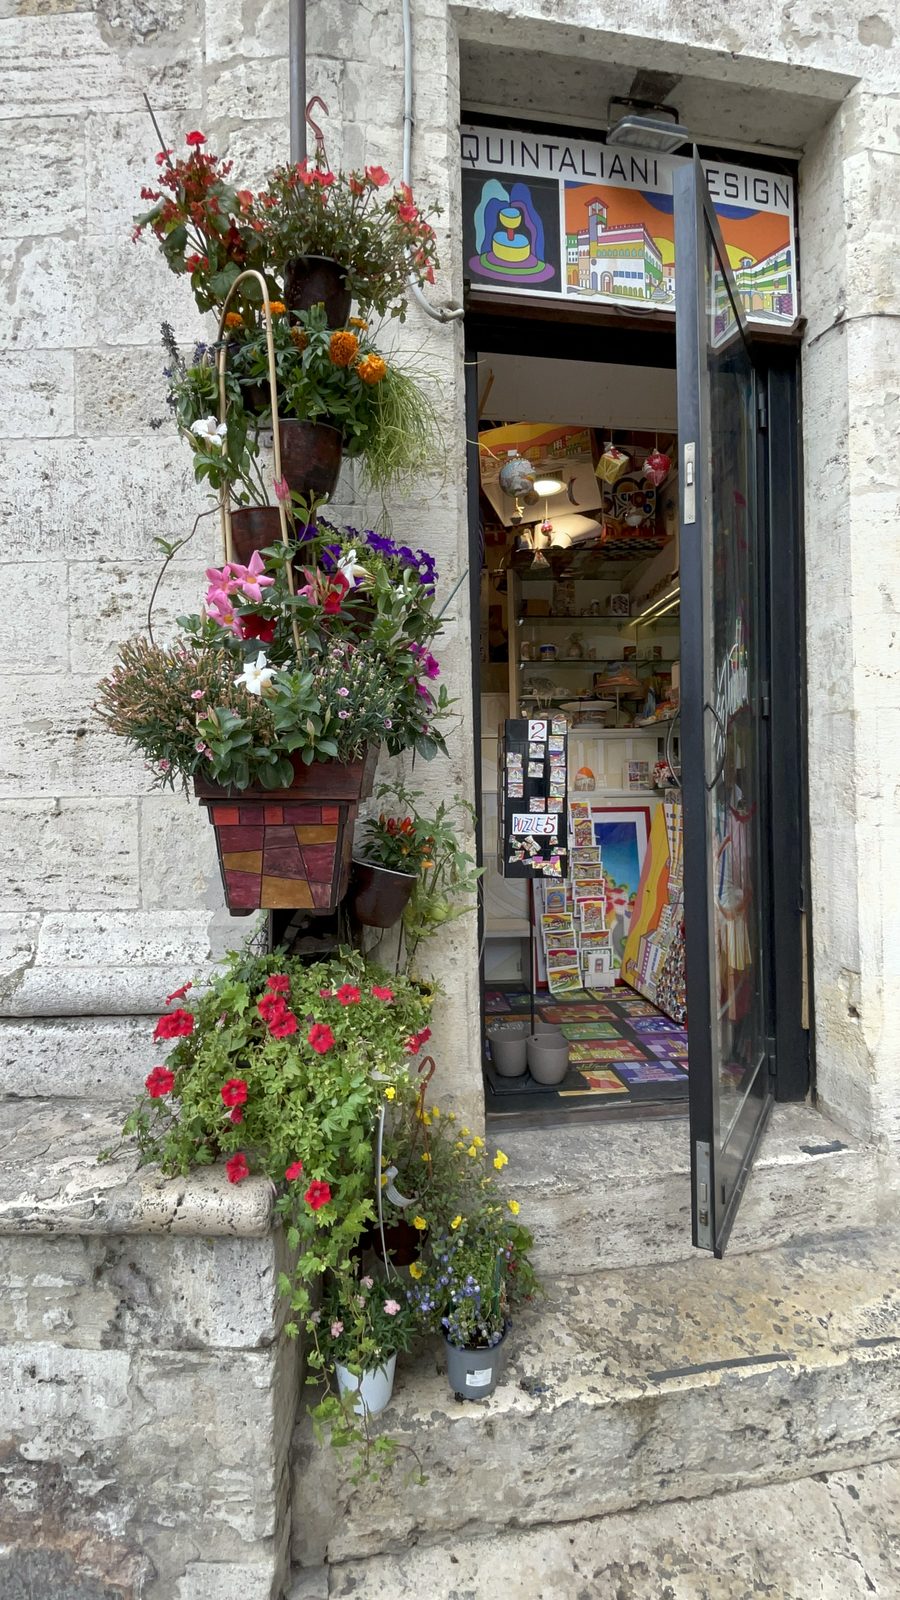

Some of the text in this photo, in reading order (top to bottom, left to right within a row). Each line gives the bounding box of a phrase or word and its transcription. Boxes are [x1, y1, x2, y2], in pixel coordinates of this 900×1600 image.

[460, 133, 790, 209] QUINTALIANI ESIGN
[530, 721, 546, 740] 2
